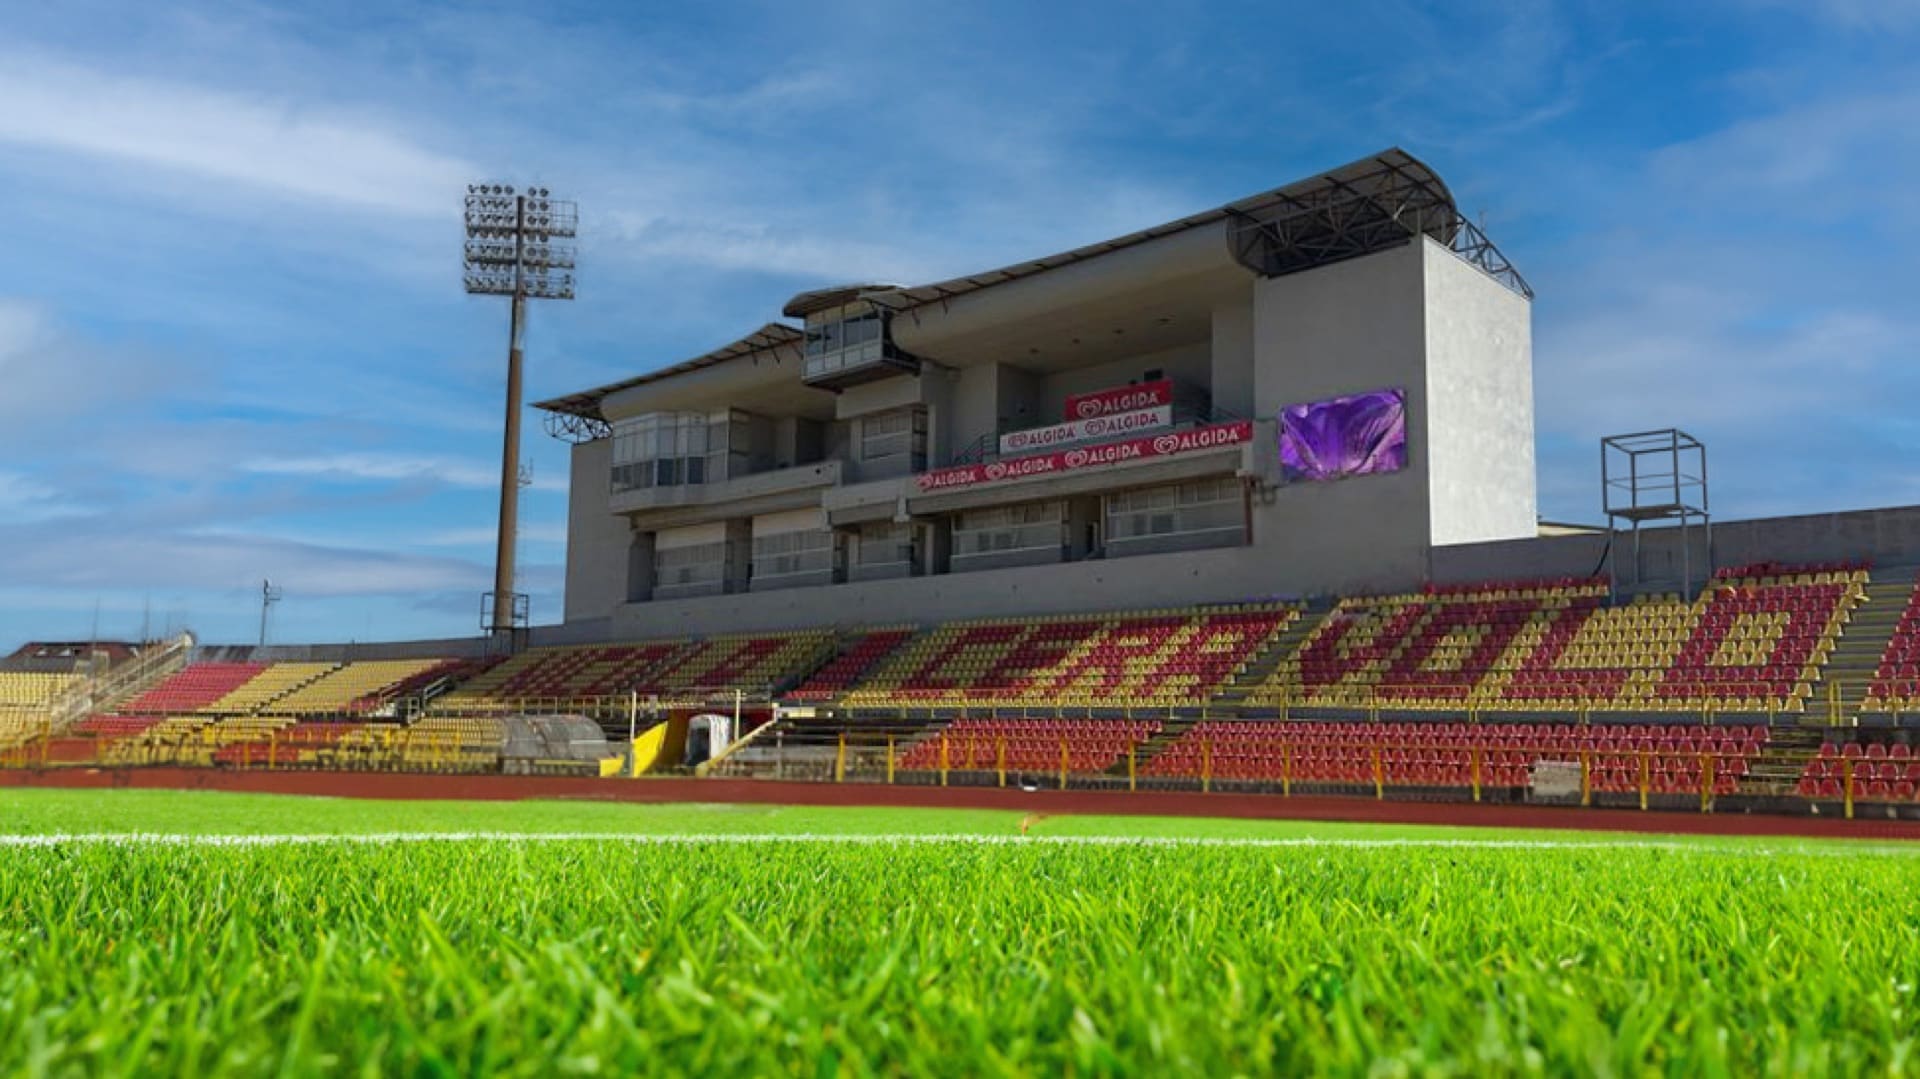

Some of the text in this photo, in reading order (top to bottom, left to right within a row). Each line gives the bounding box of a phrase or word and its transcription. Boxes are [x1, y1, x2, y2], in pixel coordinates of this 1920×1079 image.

[1103, 391, 1158, 414] ALGIDA
[1029, 412, 1159, 445] ALGIDA ALGIDA
[934, 427, 1240, 486] ALGIDA ALGIDA ALGIDA ALGIDA
